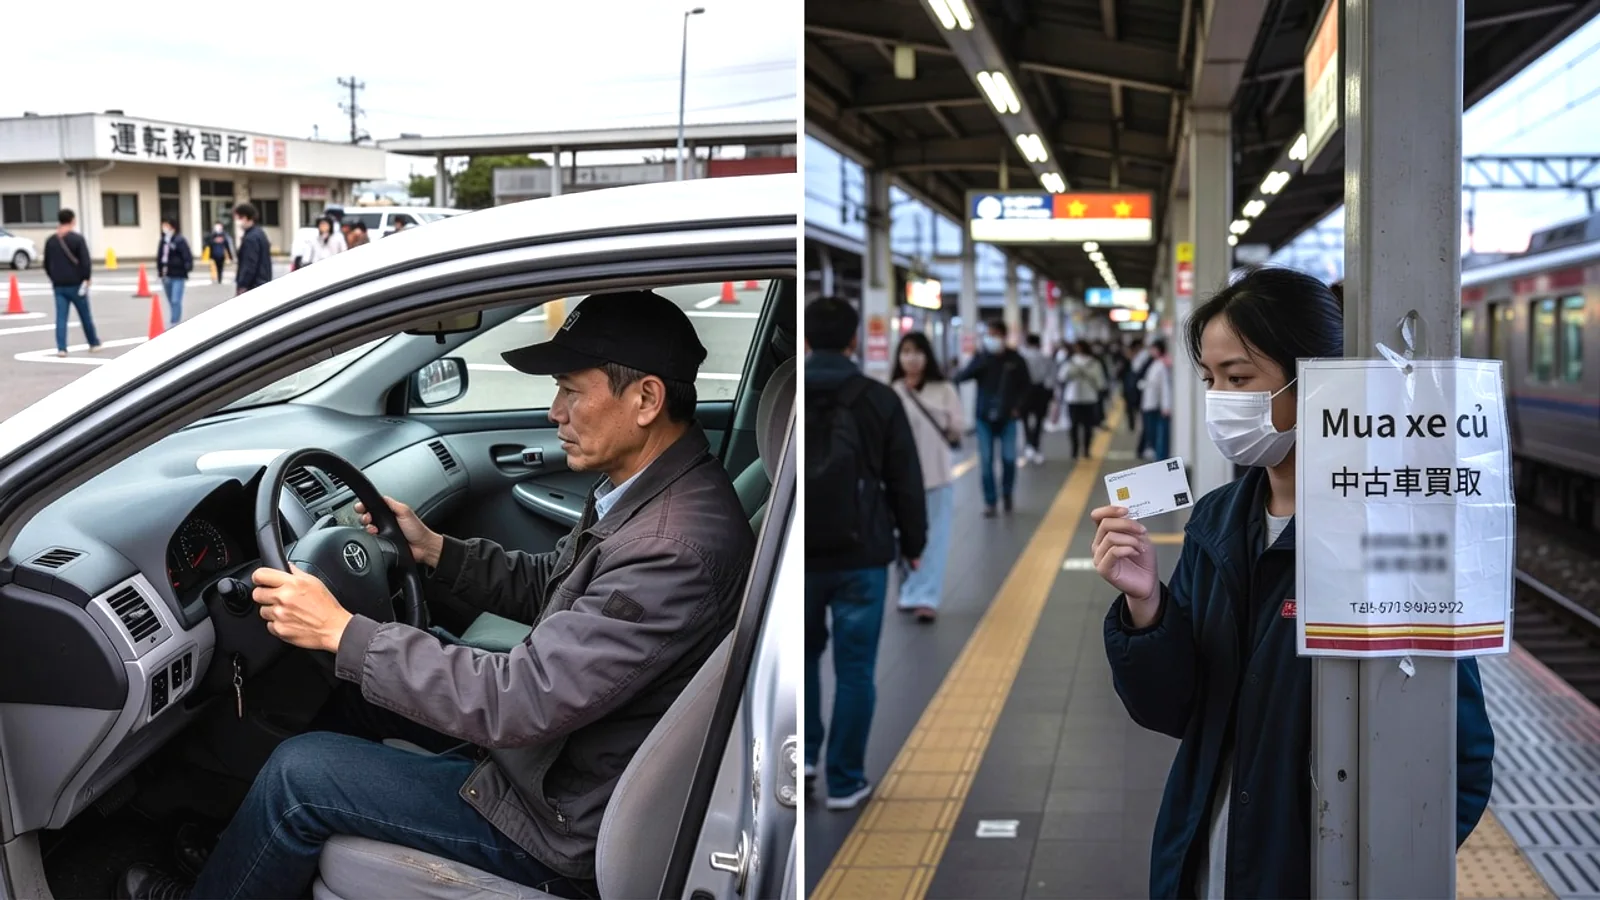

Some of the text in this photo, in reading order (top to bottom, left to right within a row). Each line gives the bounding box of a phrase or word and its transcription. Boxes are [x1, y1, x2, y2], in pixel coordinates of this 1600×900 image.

[110, 122, 248, 166] 運転教習所
[1322, 404, 1489, 438] Mua xe củ
[1331, 465, 1482, 498] 中古車買取
